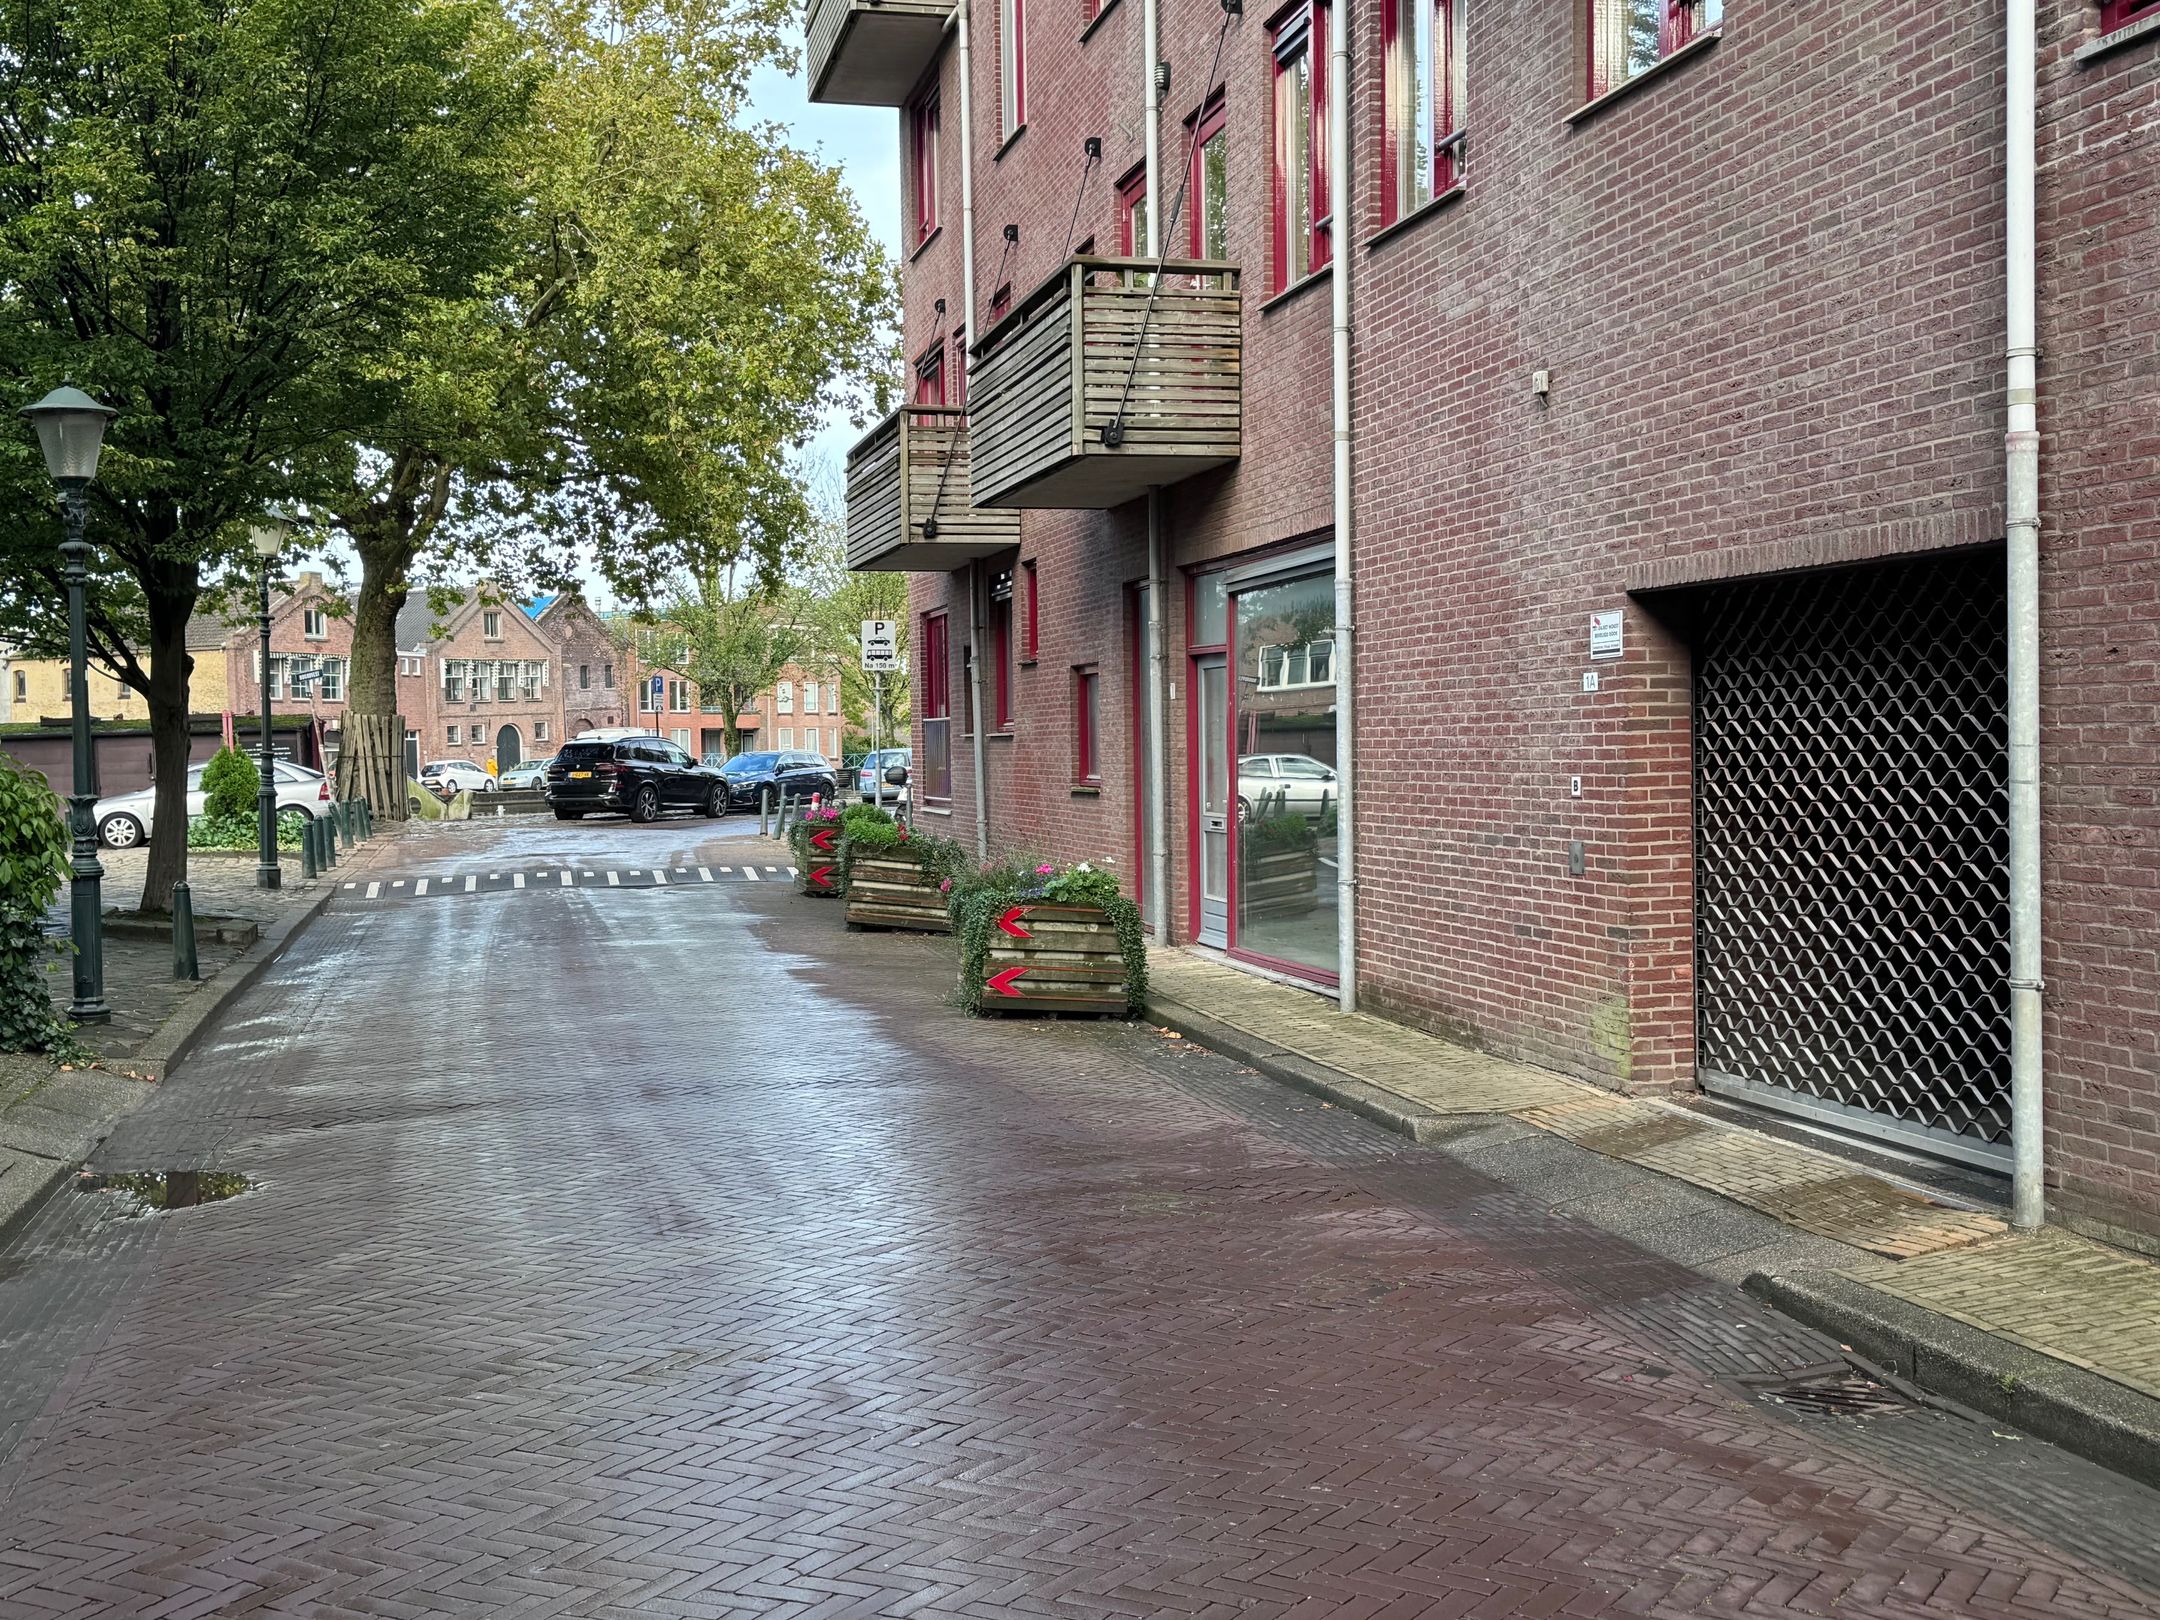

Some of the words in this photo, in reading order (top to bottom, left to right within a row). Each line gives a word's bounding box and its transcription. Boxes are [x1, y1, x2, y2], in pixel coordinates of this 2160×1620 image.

[875, 622, 885, 635] P
[655, 678, 662, 692] P
[1585, 674, 1596, 689] 1A
[1573, 779, 1579, 792] B
